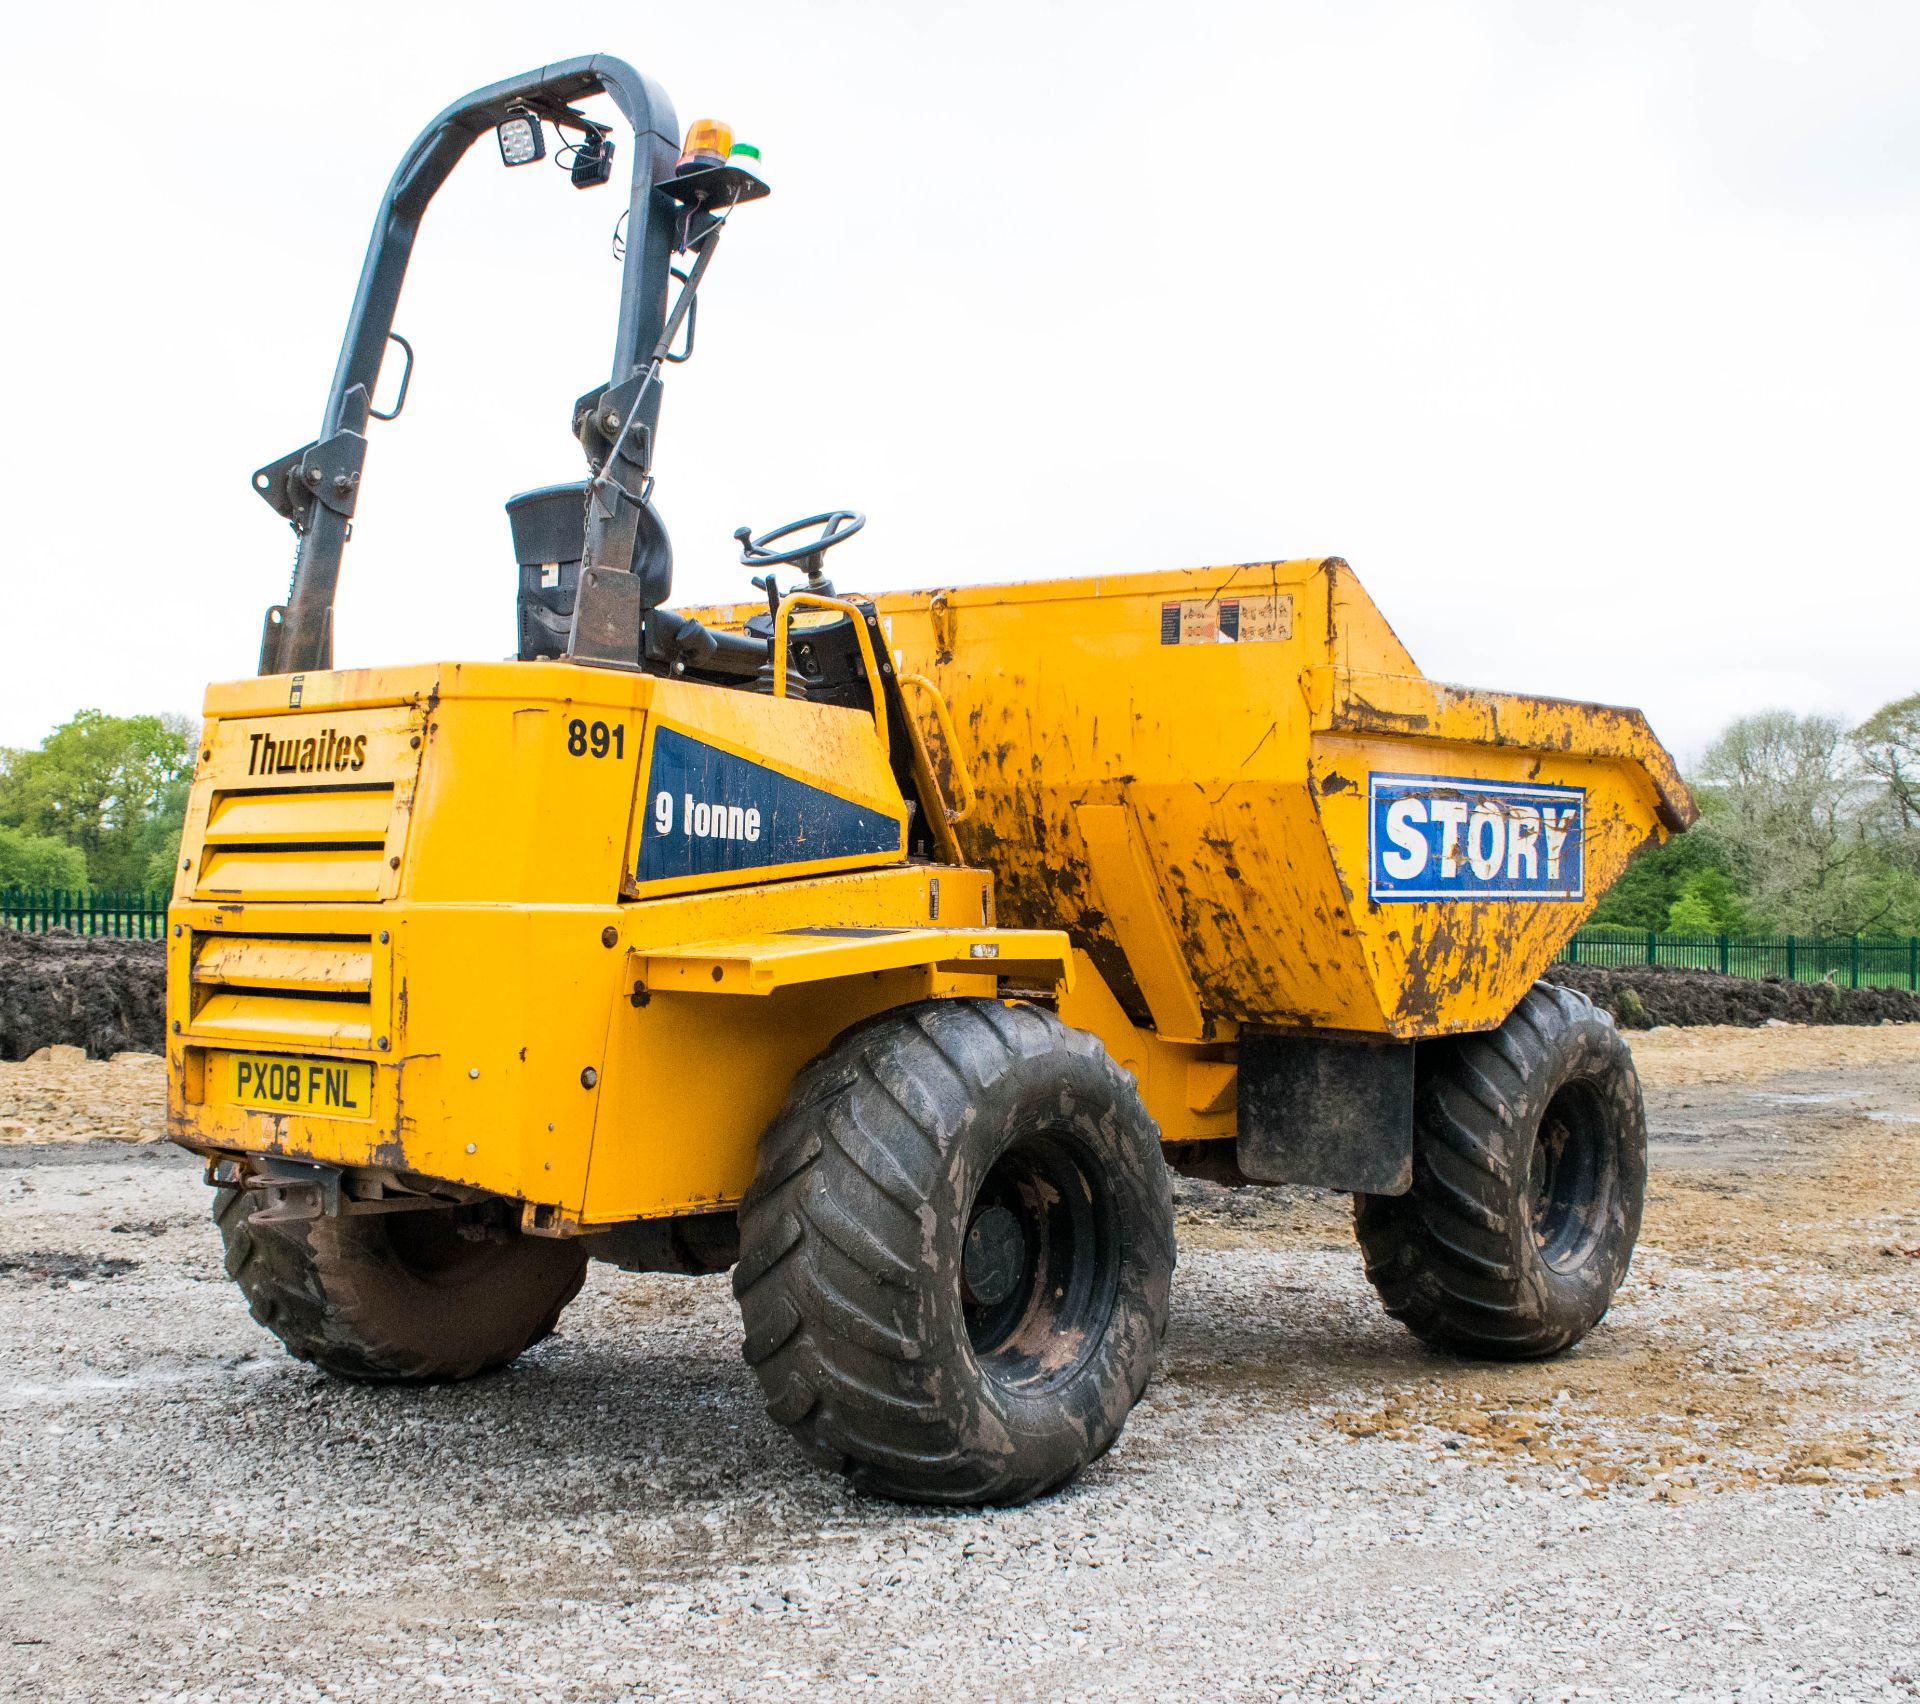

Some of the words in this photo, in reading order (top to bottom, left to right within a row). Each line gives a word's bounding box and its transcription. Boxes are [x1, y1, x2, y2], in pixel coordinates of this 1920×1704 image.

[248, 728, 368, 776] Thwaites
[567, 718, 625, 760] 891
[655, 791, 674, 834] 9
[684, 793, 761, 842] tonne
[1382, 798, 1577, 880] STORY
[238, 1061, 300, 1102] PX08
[308, 1066, 357, 1108] FNL
